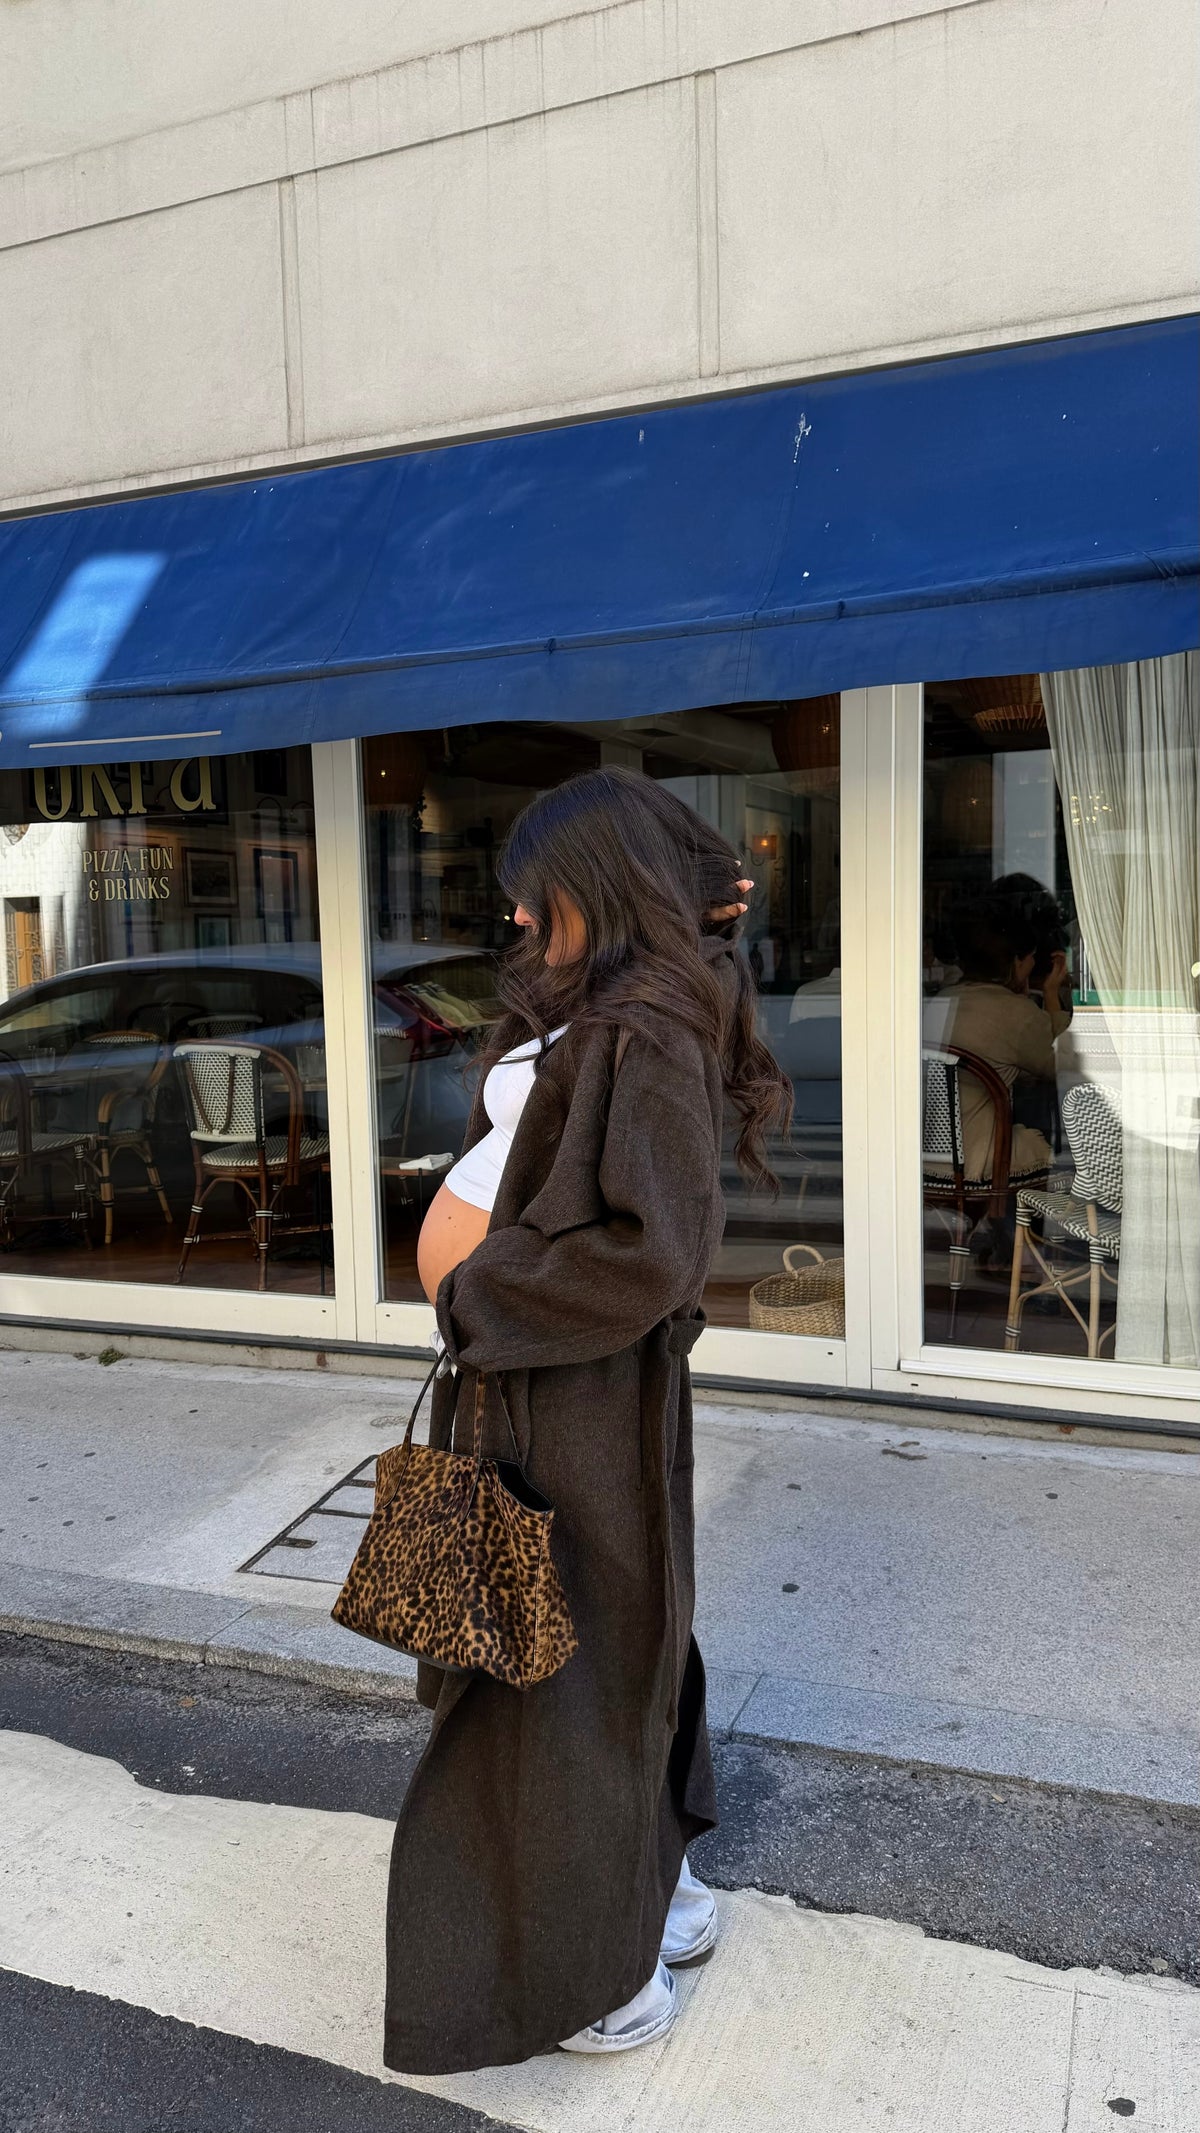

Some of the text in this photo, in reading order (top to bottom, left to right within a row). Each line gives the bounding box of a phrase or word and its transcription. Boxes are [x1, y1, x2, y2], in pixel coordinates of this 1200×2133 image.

[82, 847, 174, 873] PIZZA, FUN
[89, 876, 170, 901] & DRINKS
